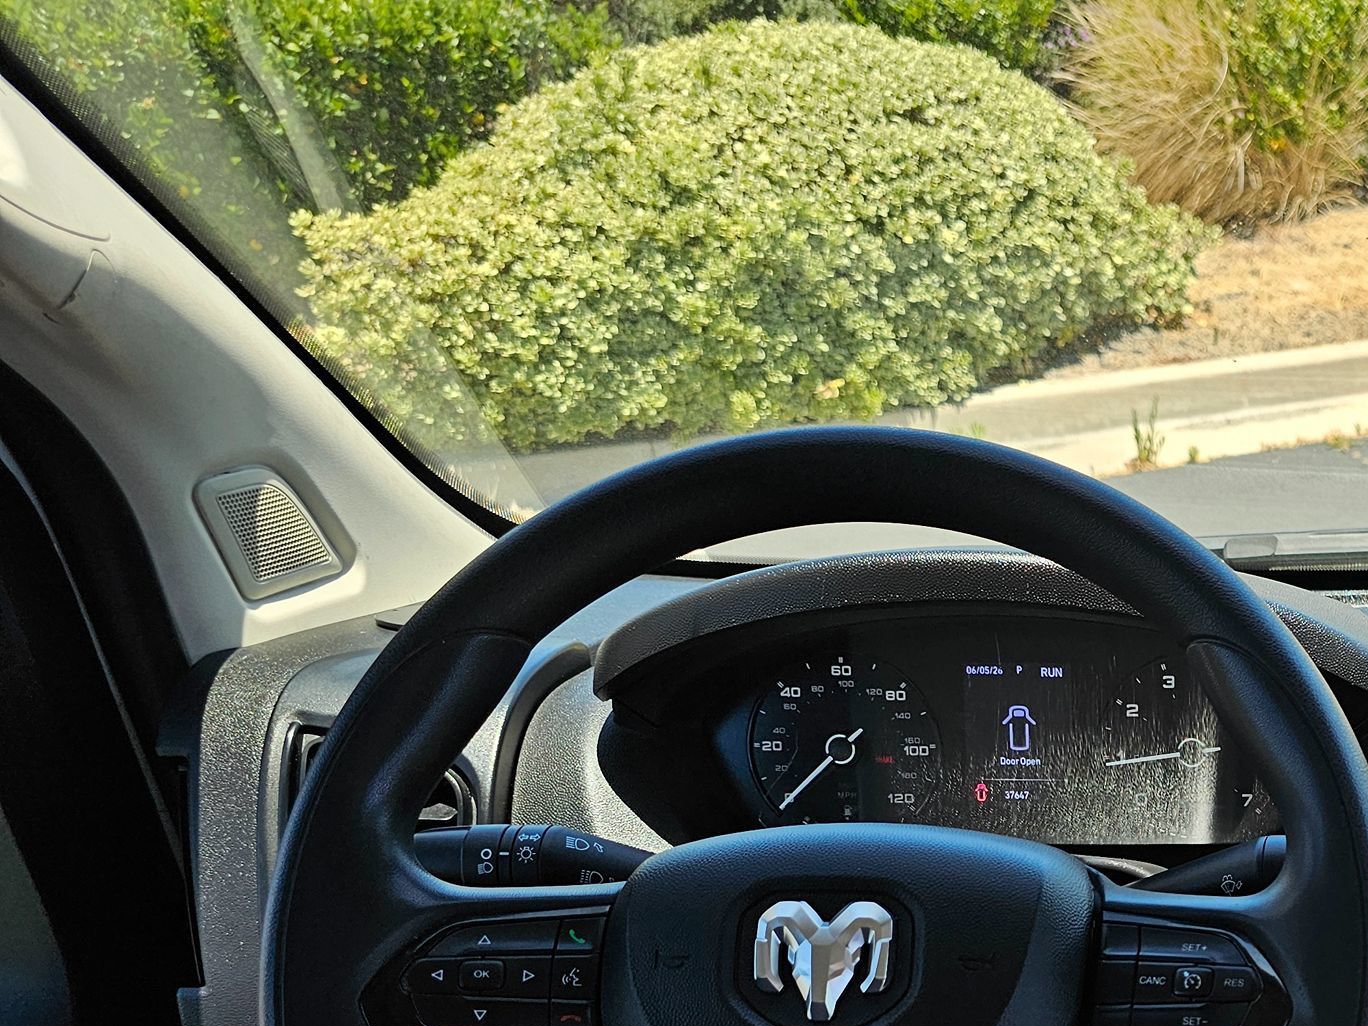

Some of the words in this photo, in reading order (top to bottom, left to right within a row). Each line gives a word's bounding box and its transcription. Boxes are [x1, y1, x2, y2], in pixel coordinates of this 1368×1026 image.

[831, 665, 852, 676] 60
[966, 666, 1003, 675] 06/05/26
[1016, 666, 1023, 674] P
[1040, 667, 1063, 677] RUN
[1162, 675, 1175, 689] 3
[780, 687, 801, 698] 40
[885, 690, 906, 701] 80
[1126, 703, 1139, 717] 2
[762, 741, 782, 751] 20
[903, 746, 929, 756] 100
[1000, 757, 1019, 765] Door
[1020, 757, 1041, 766] Open
[888, 793, 915, 803] 120
[1005, 791, 1029, 800] 37647
[1241, 793, 1253, 806] 7
[473, 969, 490, 979] OK
[1139, 975, 1167, 985] CANC
[1224, 978, 1245, 988] RES
